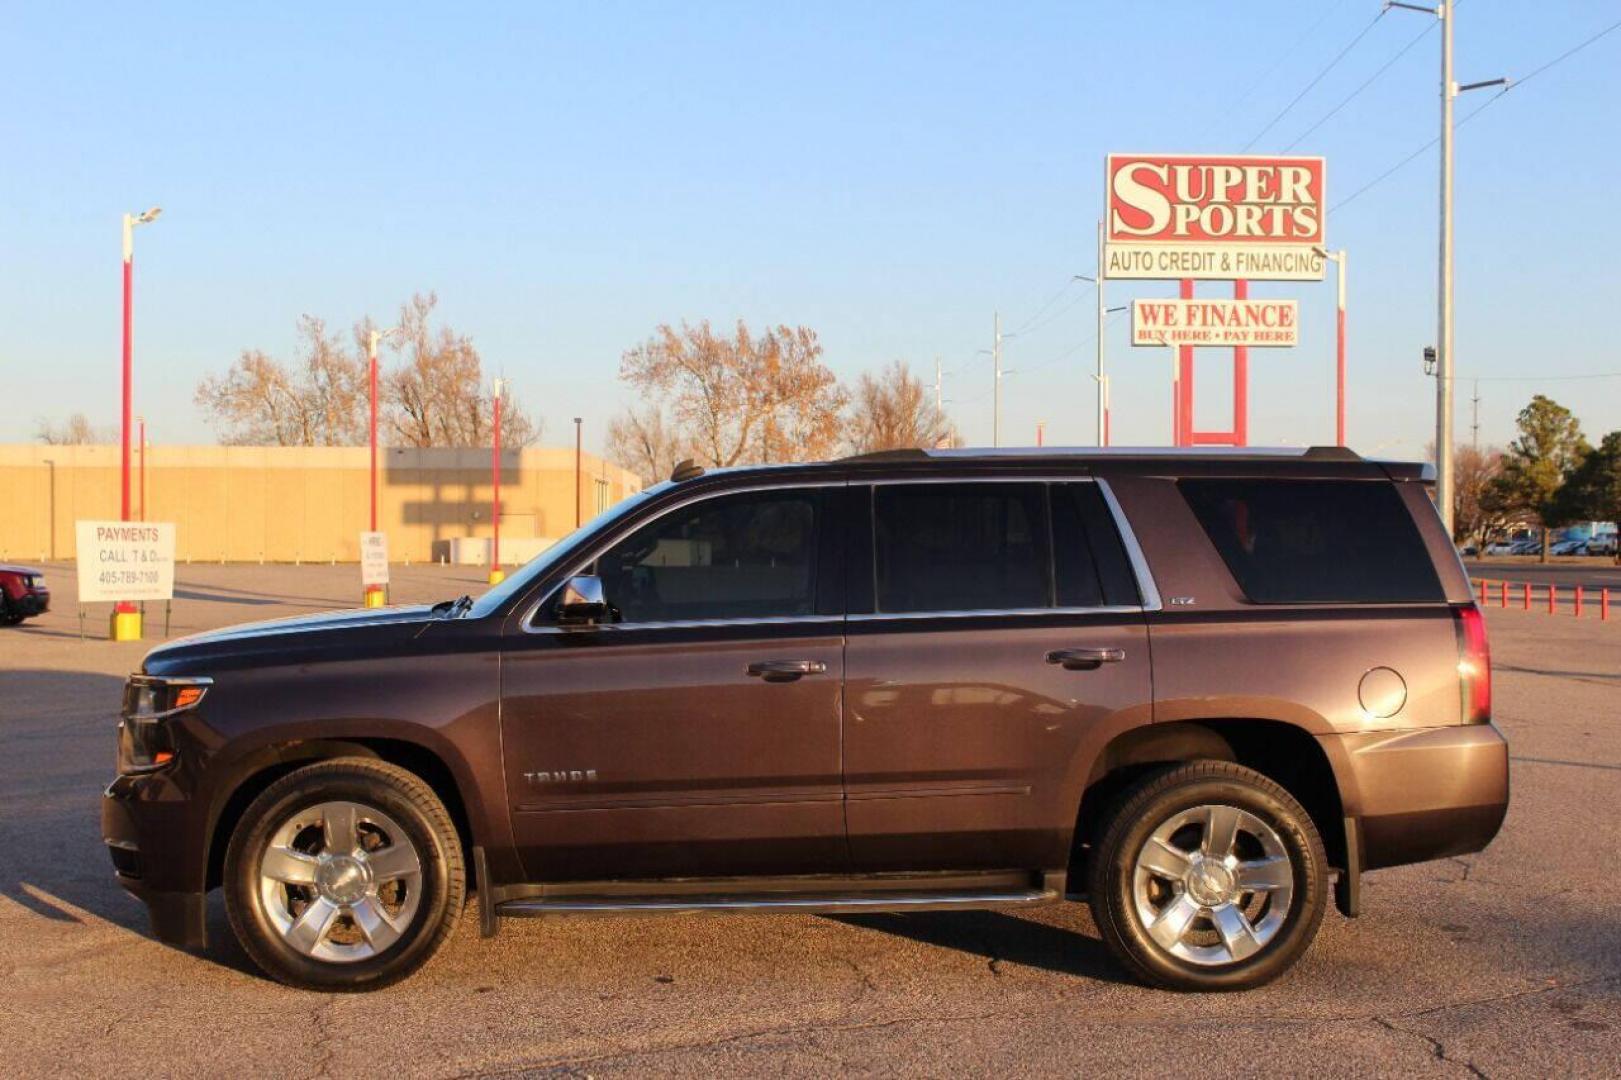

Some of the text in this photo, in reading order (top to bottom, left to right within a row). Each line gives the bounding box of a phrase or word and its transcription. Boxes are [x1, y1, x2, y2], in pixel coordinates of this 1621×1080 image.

[1113, 161, 1316, 235] SUPER
[1110, 251, 1321, 273] AUTO CREDIT & FINANCING
[1138, 303, 1293, 328] WE FINANCE
[1138, 330, 1294, 342] BUY HERE PAY HERE
[96, 527, 159, 542] PAYMENTS
[99, 549, 126, 562] CALL
[132, 549, 139, 562] T
